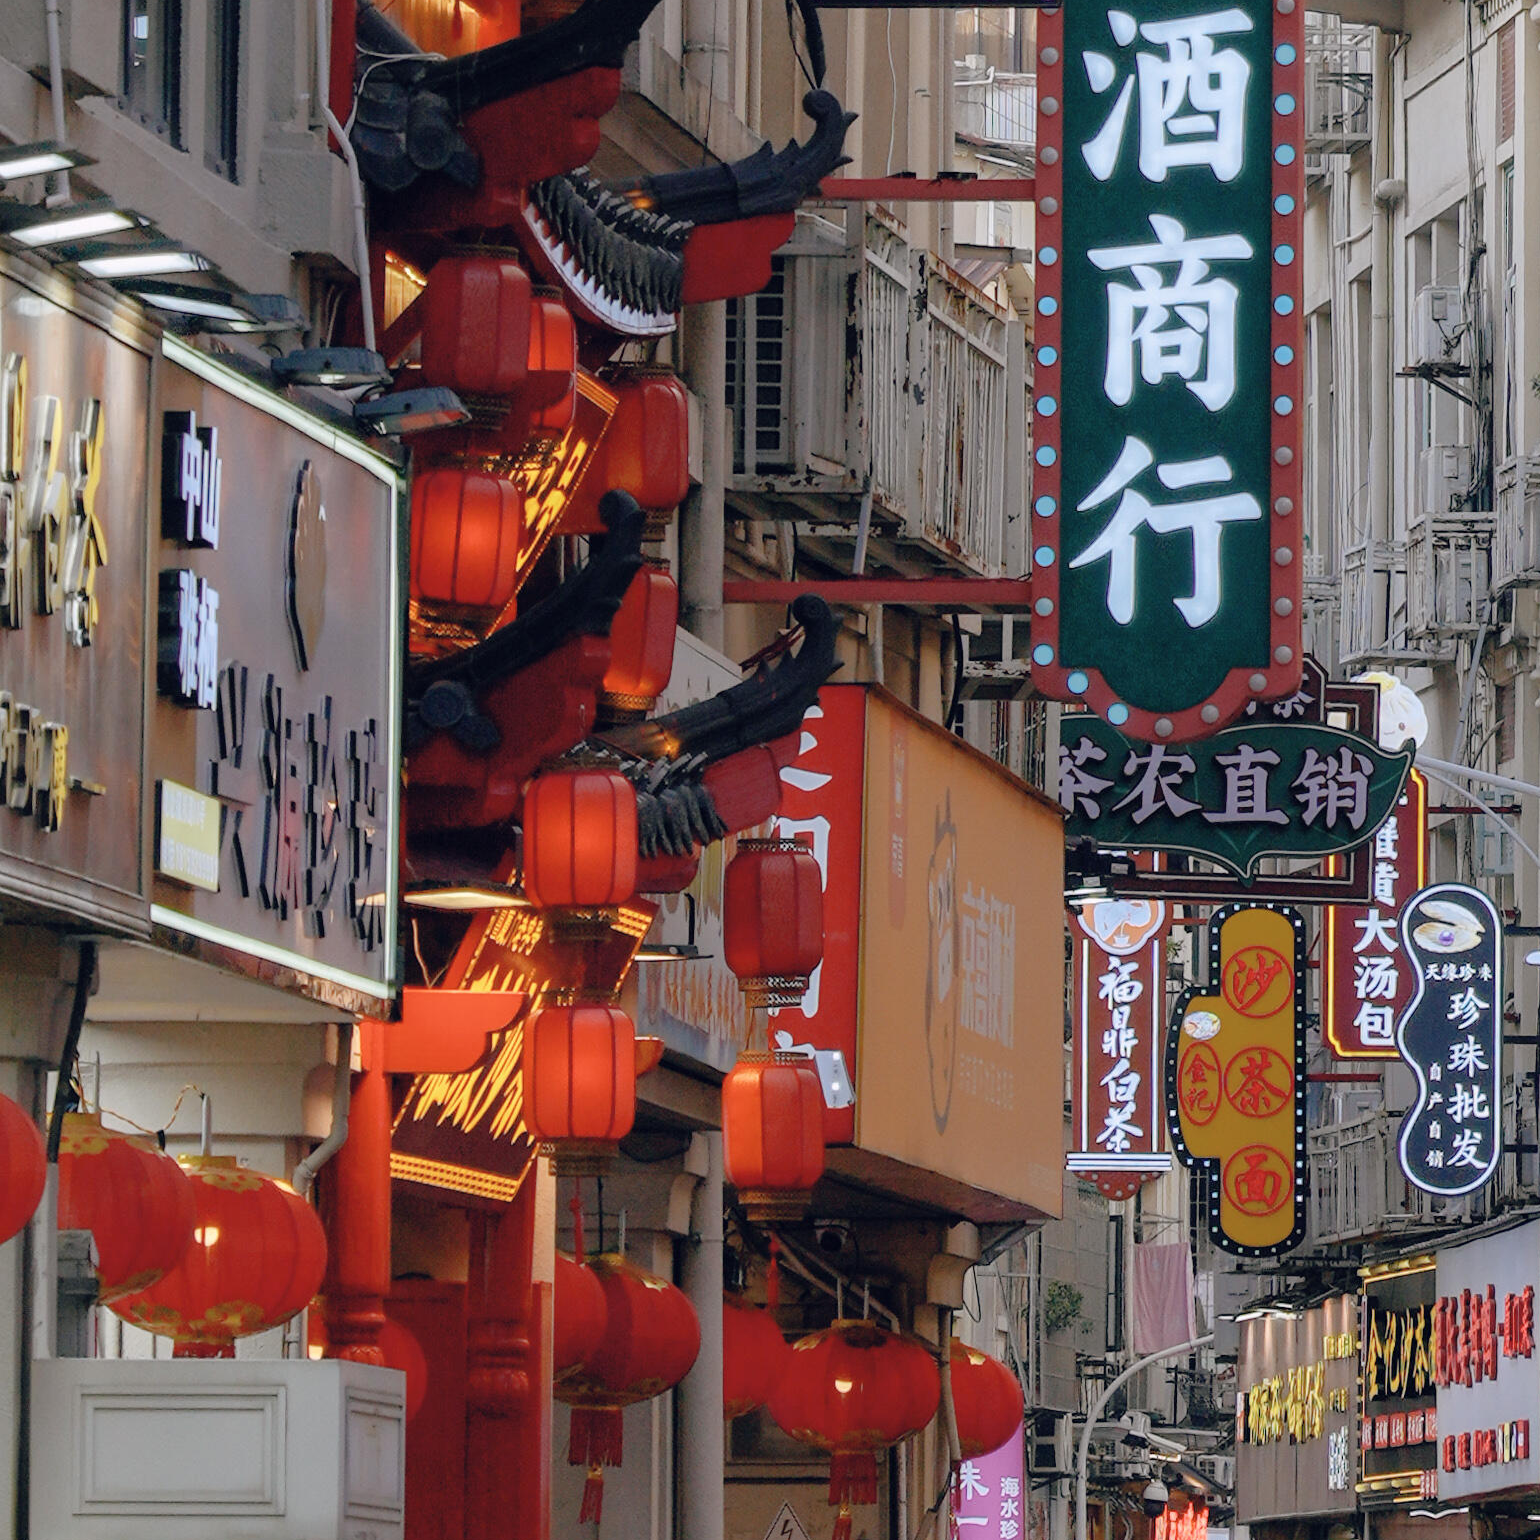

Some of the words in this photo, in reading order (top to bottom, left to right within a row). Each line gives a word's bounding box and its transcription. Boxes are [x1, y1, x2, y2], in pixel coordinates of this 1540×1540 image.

[1058, 736, 1375, 830] 茶农直销
[1095, 955, 1145, 1154] 福鼎白茶
[1228, 951, 1290, 1209] 沙茶面
[1446, 986, 1490, 1170] 珍珠批发
